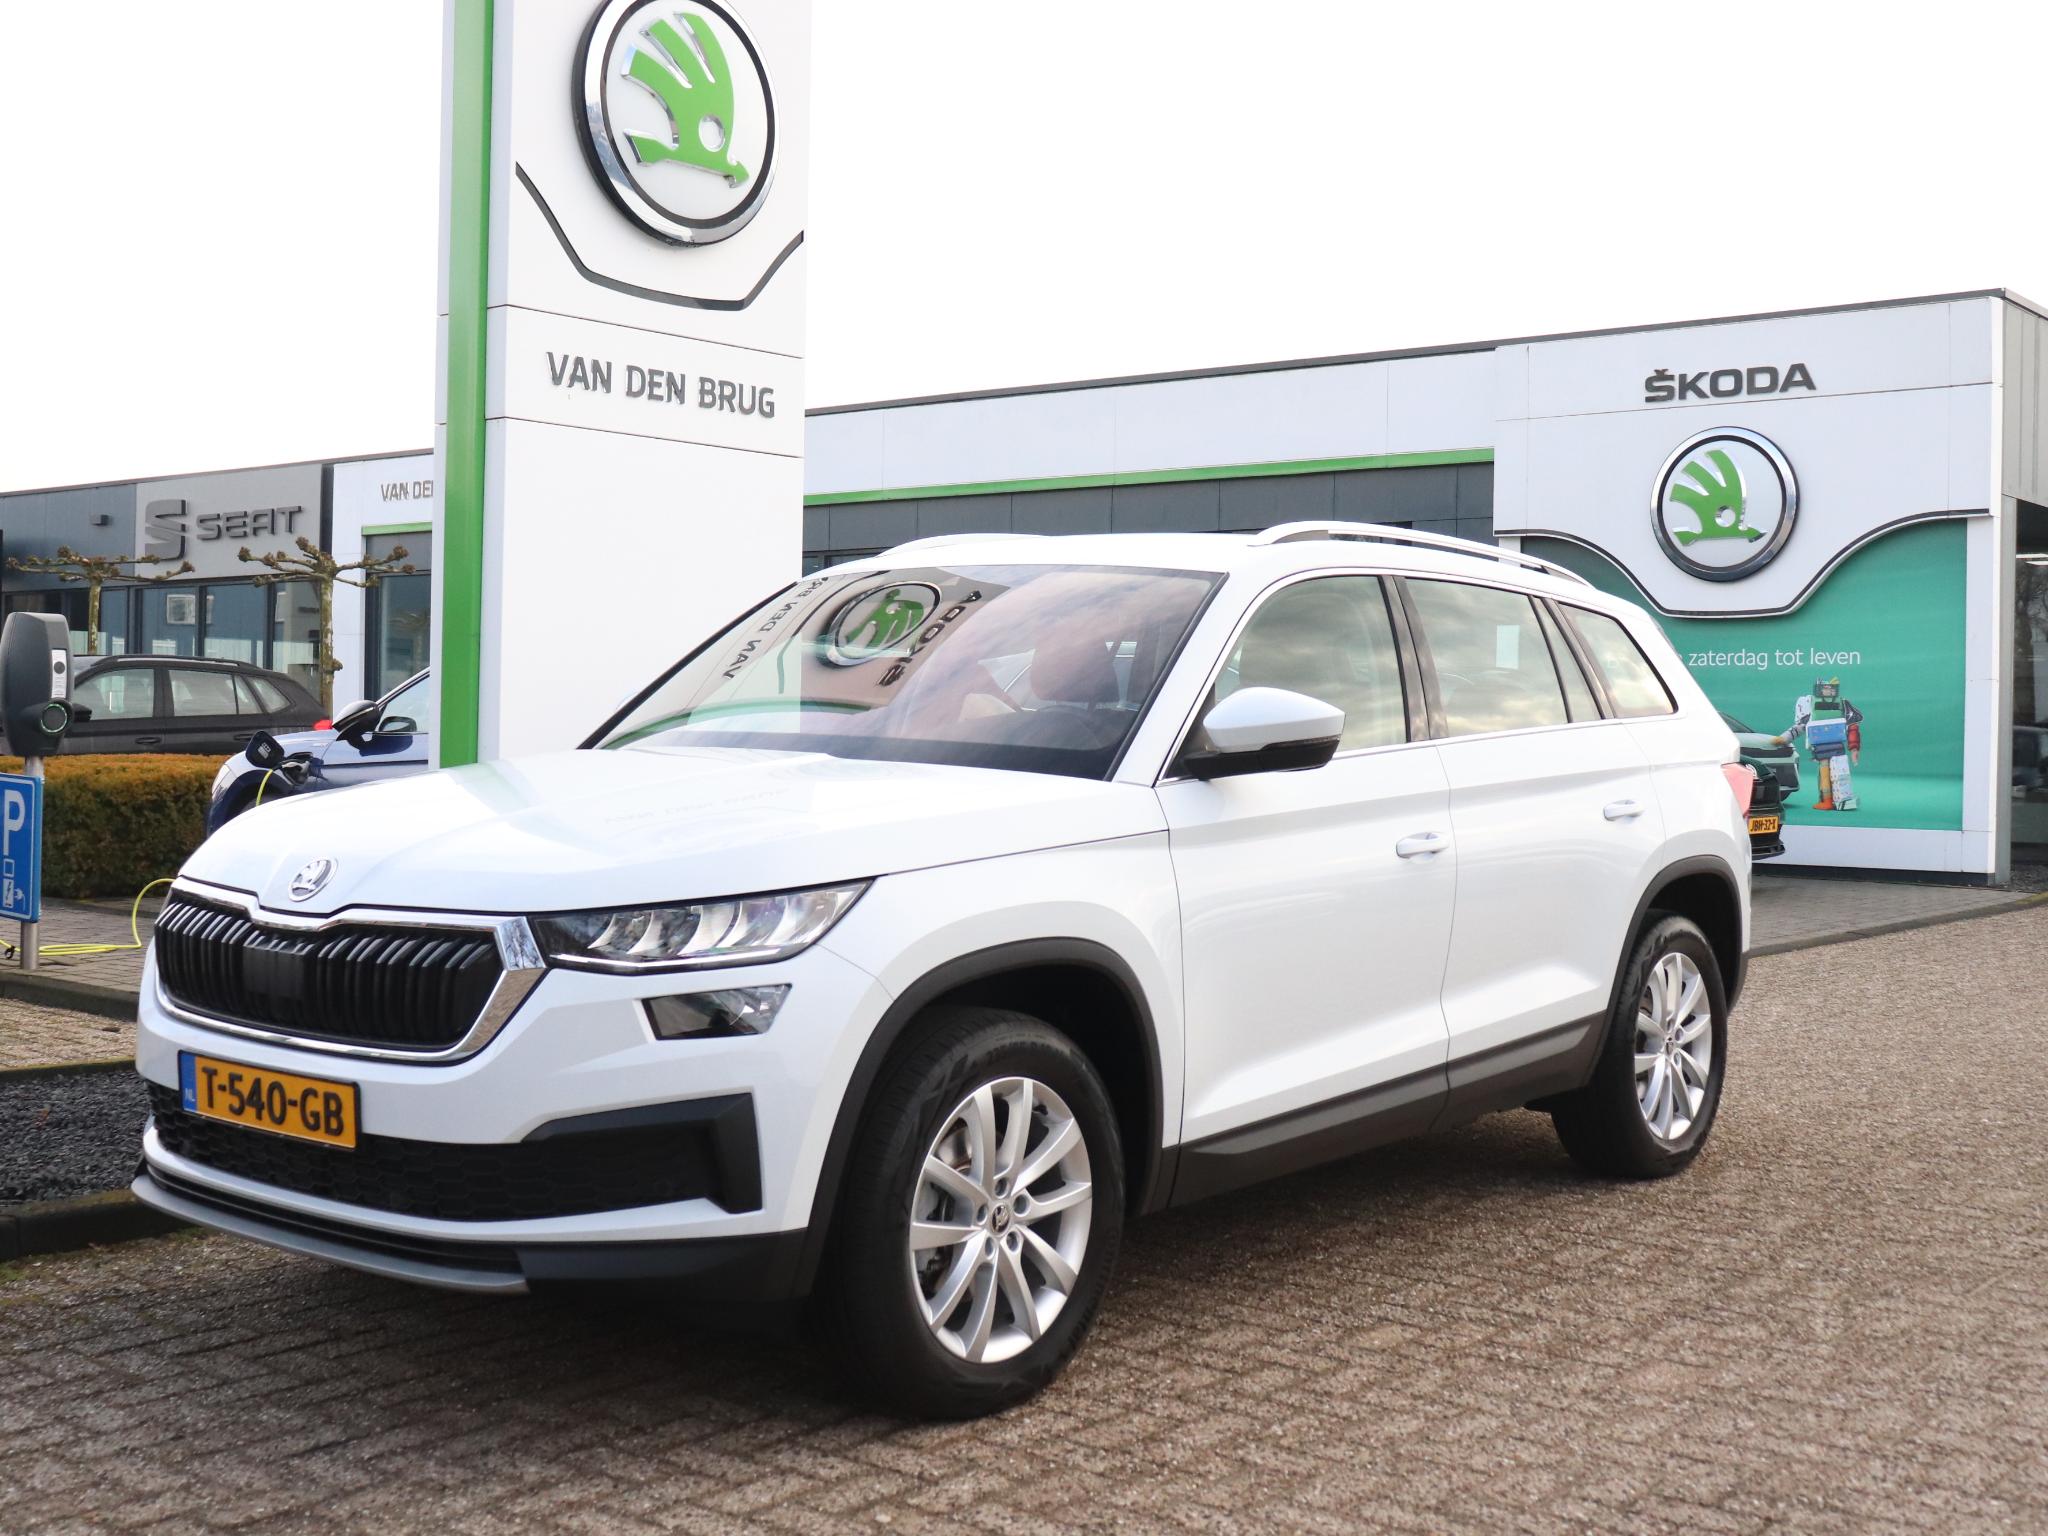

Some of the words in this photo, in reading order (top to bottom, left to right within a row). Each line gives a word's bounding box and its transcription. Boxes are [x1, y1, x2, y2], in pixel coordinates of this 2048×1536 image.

[546, 351, 612, 394] VAN
[626, 364, 686, 405] DEN
[698, 376, 775, 419] BRUG
[1645, 362, 1817, 403] ŠKODA
[380, 482, 409, 502] VAN
[196, 505, 303, 541] SEAT
[1688, 649, 1768, 671] zaterdag
[1775, 649, 1804, 666] tot
[1810, 648, 1861, 665] leven
[3, 789, 26, 856] P
[184, 1087, 196, 1102] NL
[201, 1066, 345, 1137] T-540-GB
